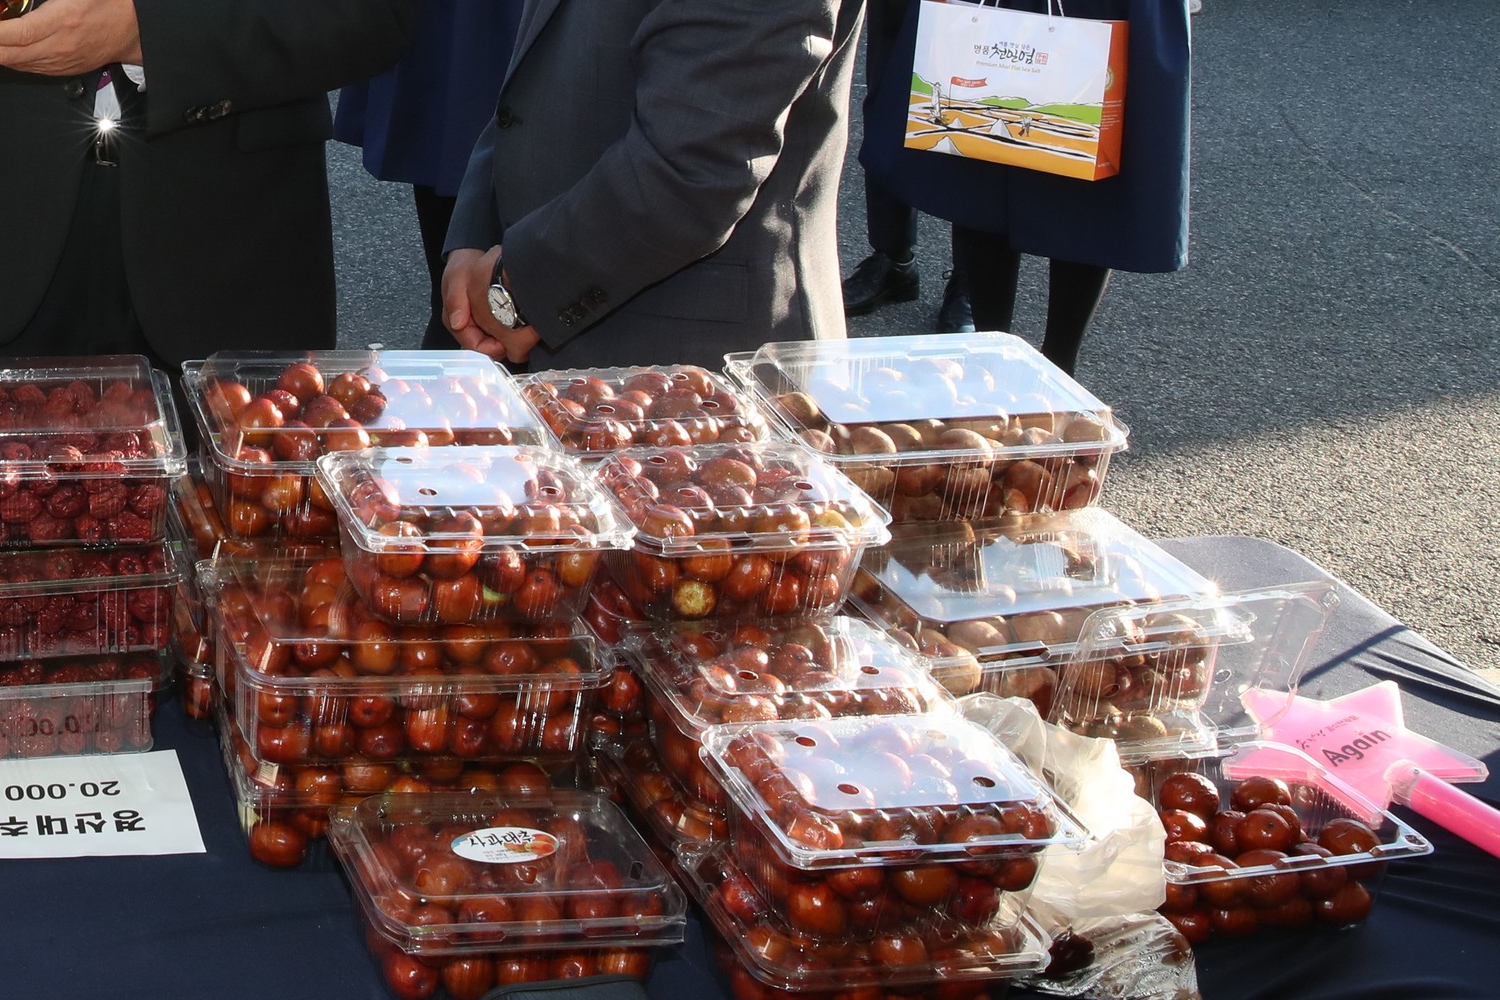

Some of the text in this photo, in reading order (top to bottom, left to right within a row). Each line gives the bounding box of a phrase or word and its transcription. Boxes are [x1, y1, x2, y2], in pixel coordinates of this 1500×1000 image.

[1321, 730, 1392, 767] Again
[0, 809, 146, 837] 경산대추
[470, 830, 533, 847] 사과대추
